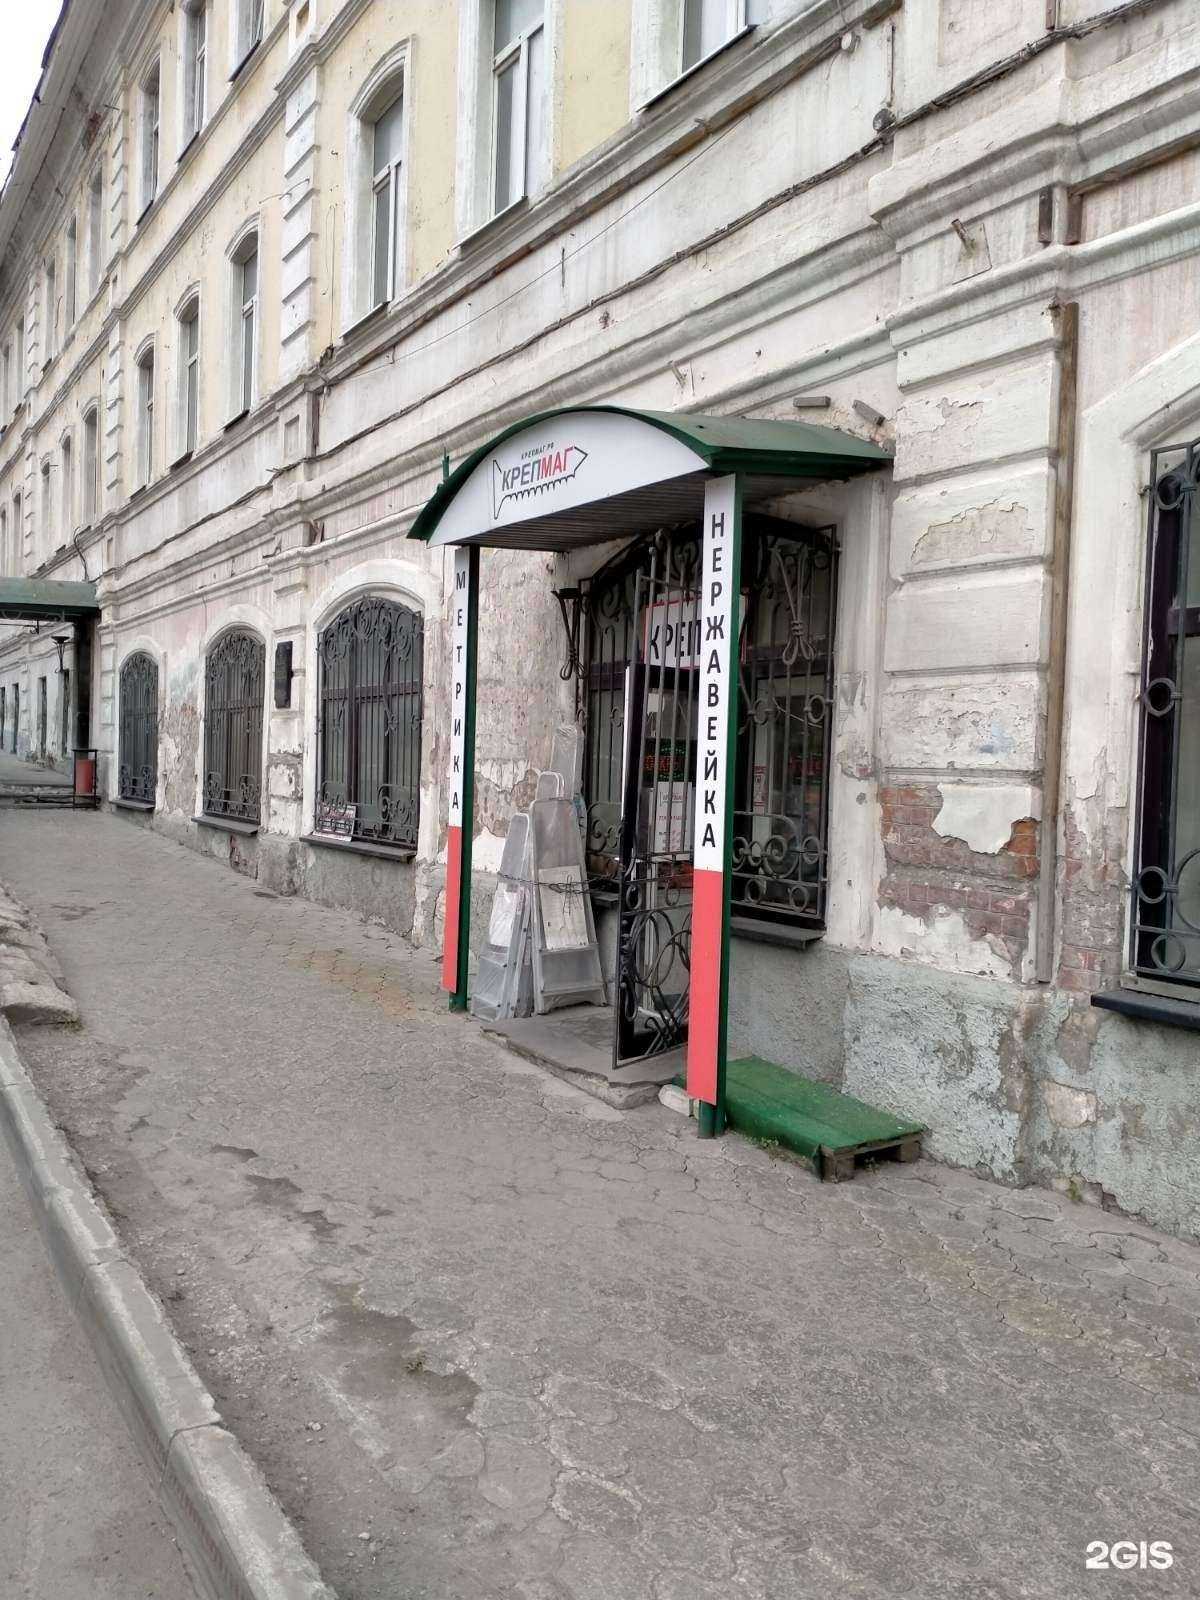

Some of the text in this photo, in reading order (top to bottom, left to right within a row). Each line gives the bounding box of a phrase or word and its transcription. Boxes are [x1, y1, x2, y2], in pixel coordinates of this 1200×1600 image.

[501, 446, 574, 491] КРЕПМАГ
[452, 571, 466, 810] МЕТРИКА
[650, 619, 702, 660] КРЕП
[702, 512, 725, 848] НЕРЖАВЕЙКА
